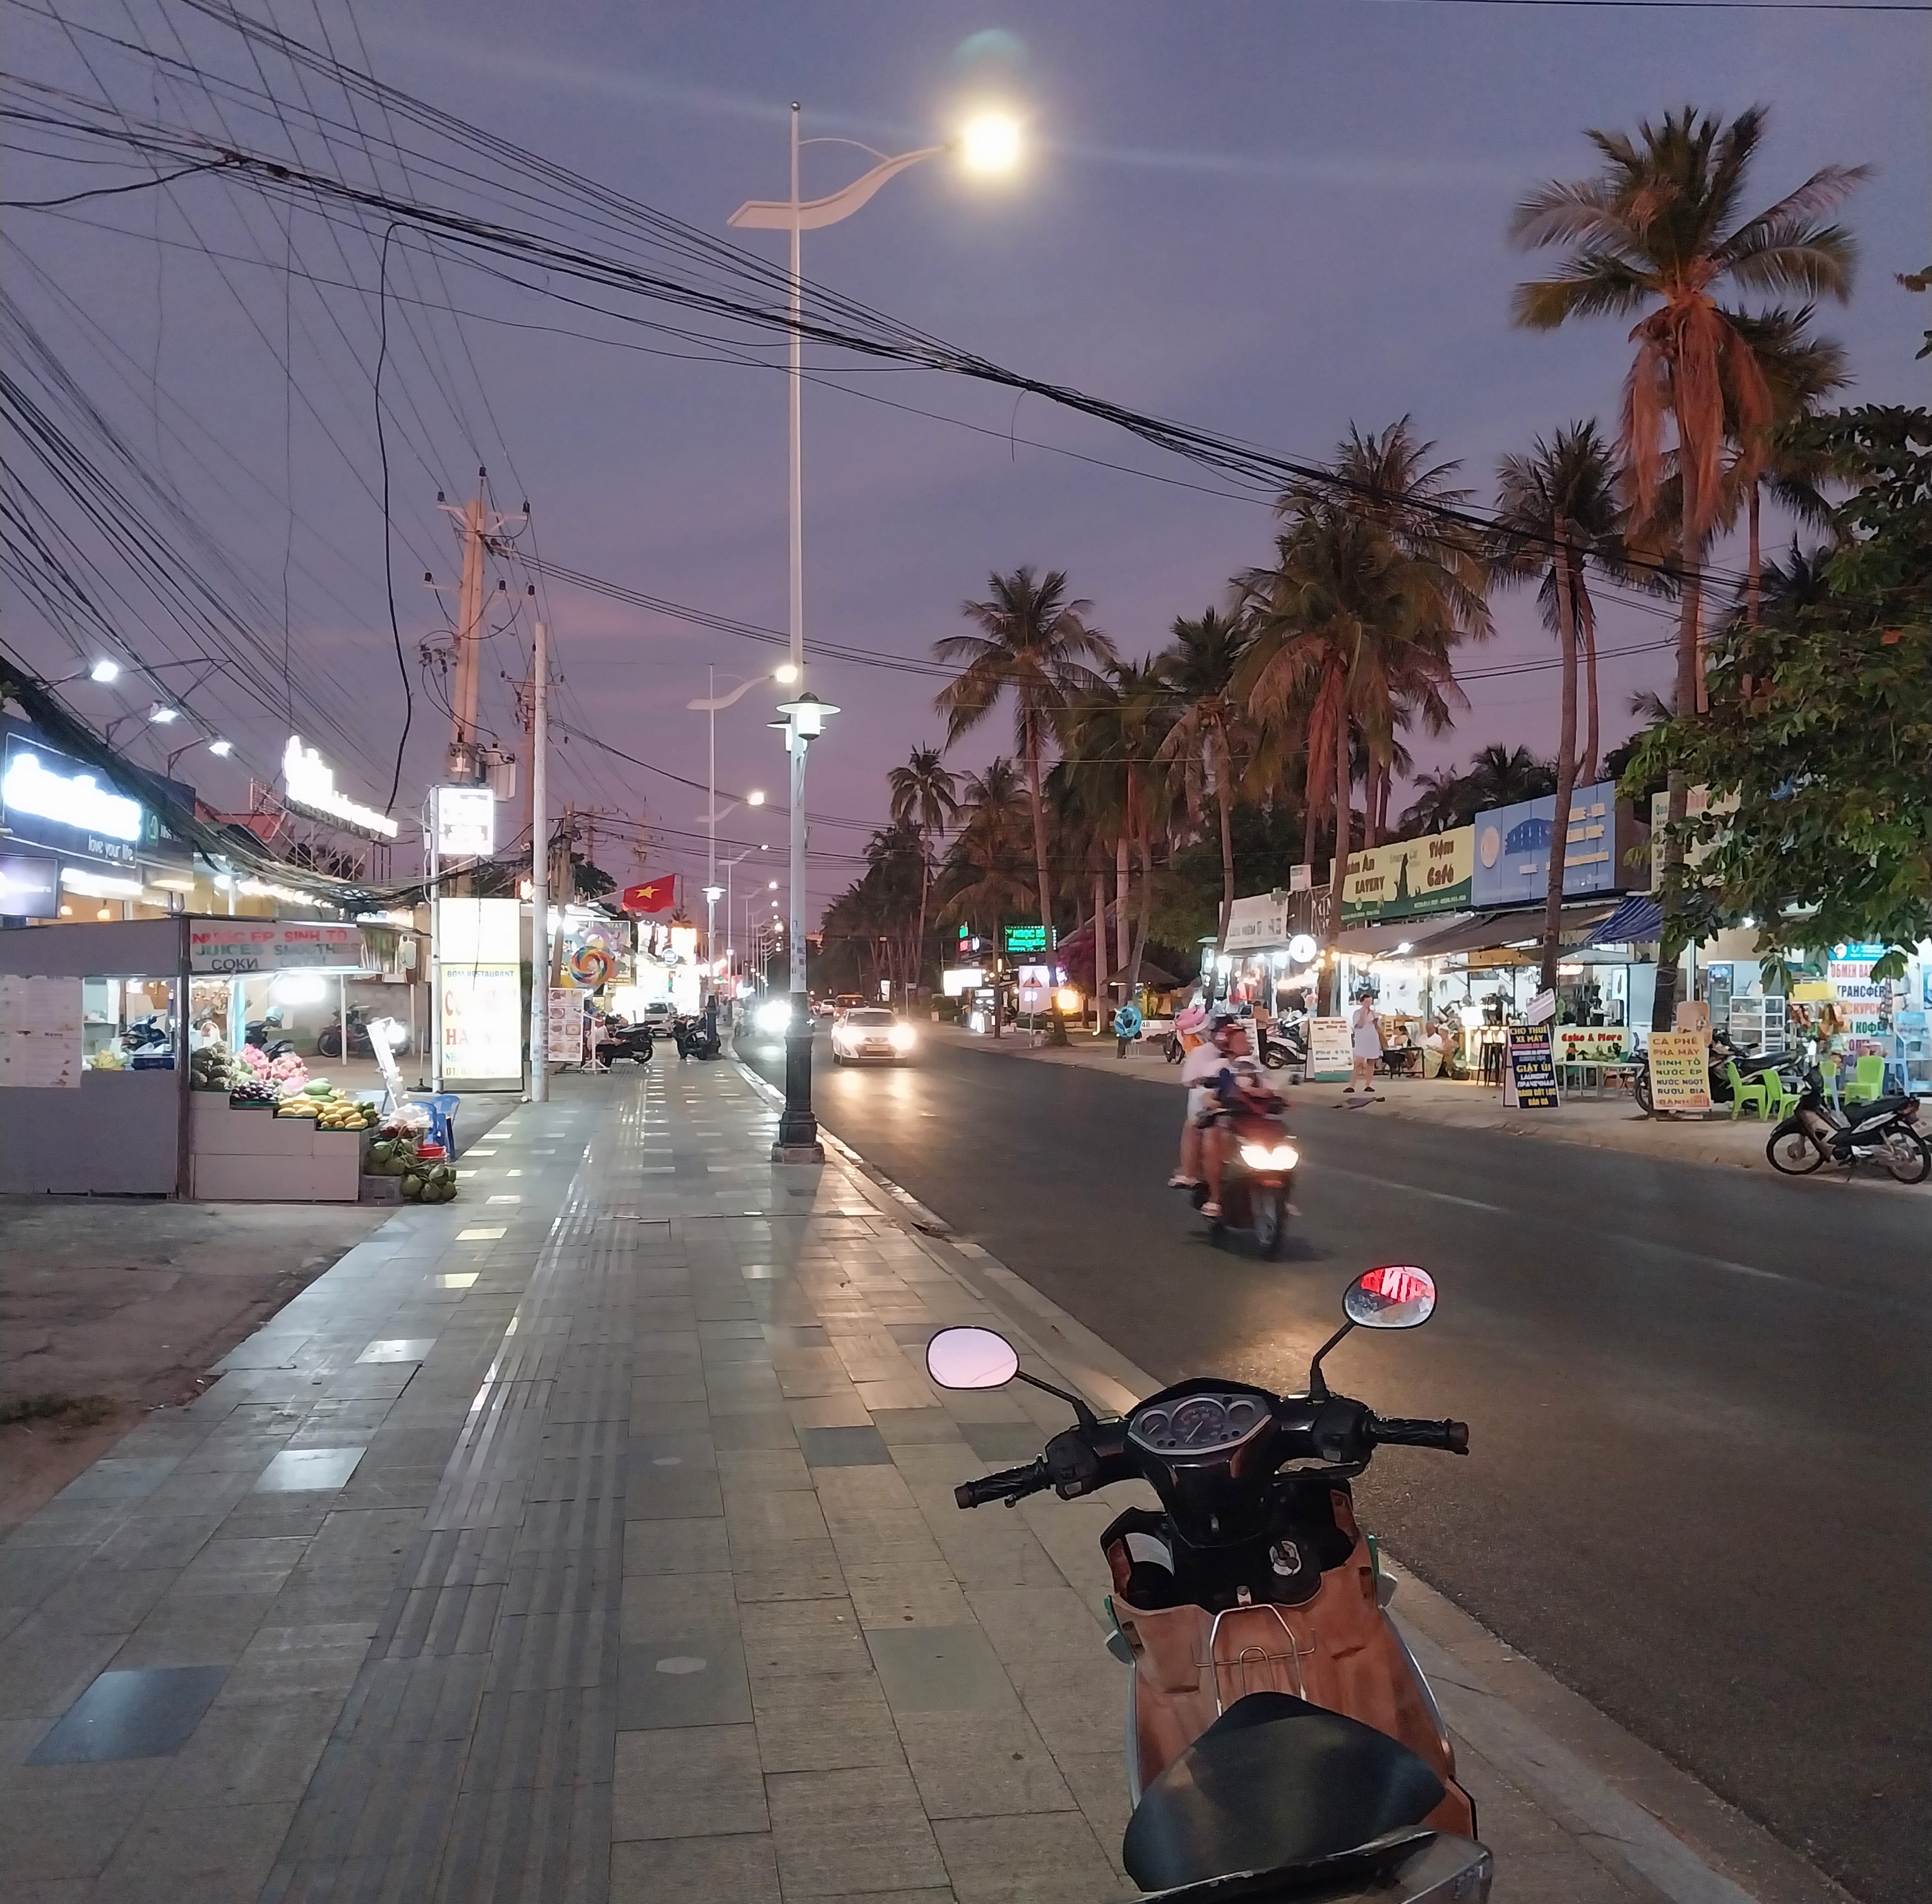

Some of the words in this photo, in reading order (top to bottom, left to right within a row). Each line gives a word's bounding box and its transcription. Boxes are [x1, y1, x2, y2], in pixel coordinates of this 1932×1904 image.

[1427, 864, 1454, 887] Café
[1355, 876, 1385, 895] EATERY
[284, 930, 320, 943] SINH
[196, 944, 264, 956] JUICES
[1832, 964, 1856, 978] ОБМЕН
[1674, 1037, 1698, 1045] PHÊ
